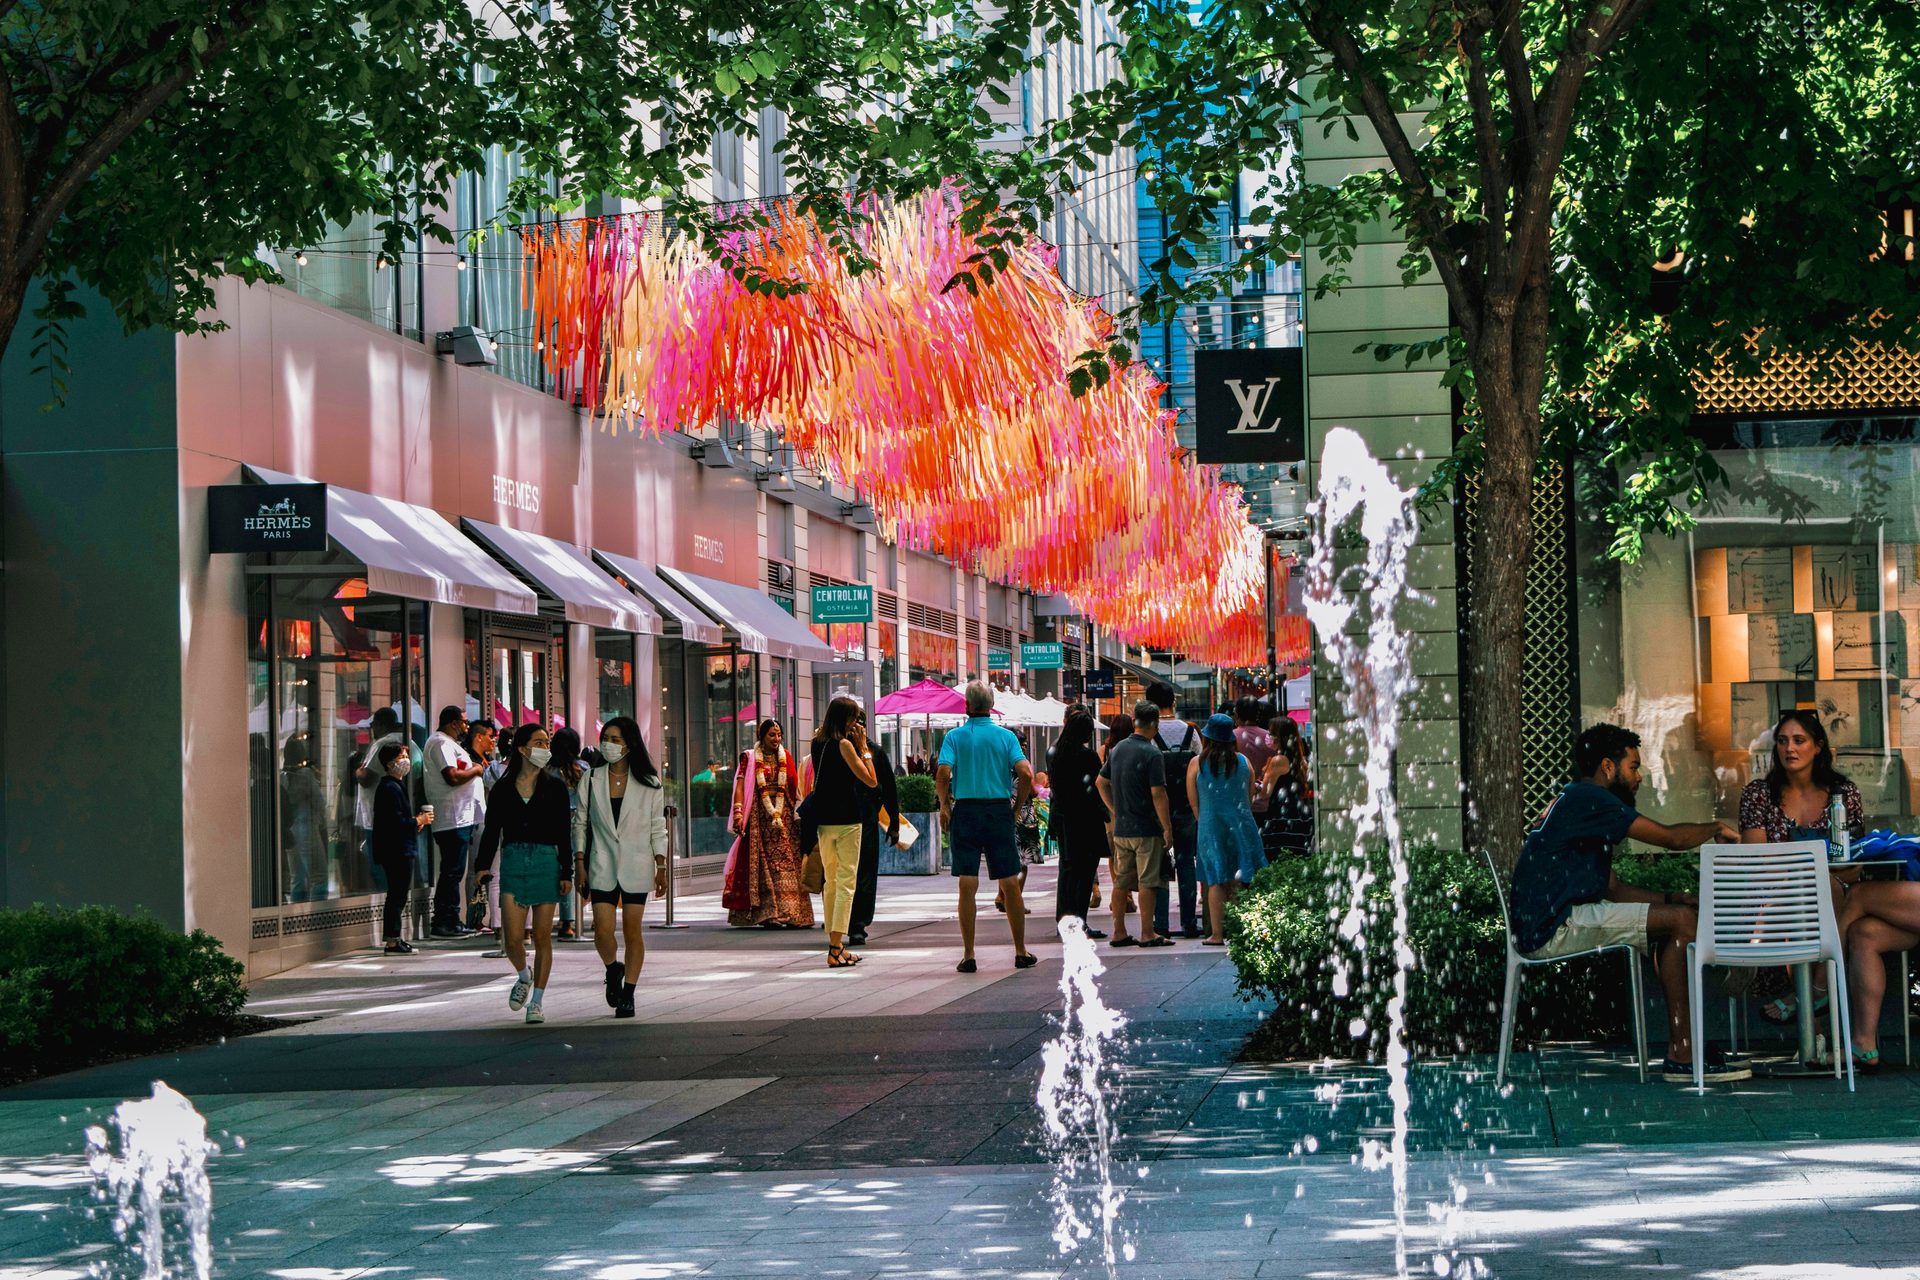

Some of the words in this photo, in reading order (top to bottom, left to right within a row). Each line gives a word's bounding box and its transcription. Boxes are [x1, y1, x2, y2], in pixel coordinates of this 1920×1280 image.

[244, 515, 311, 530] HERMÈS
[263, 531, 291, 539] PARIS
[816, 589, 869, 602] CENTROLINA
[1023, 645, 1060, 654] CENTROLINA
